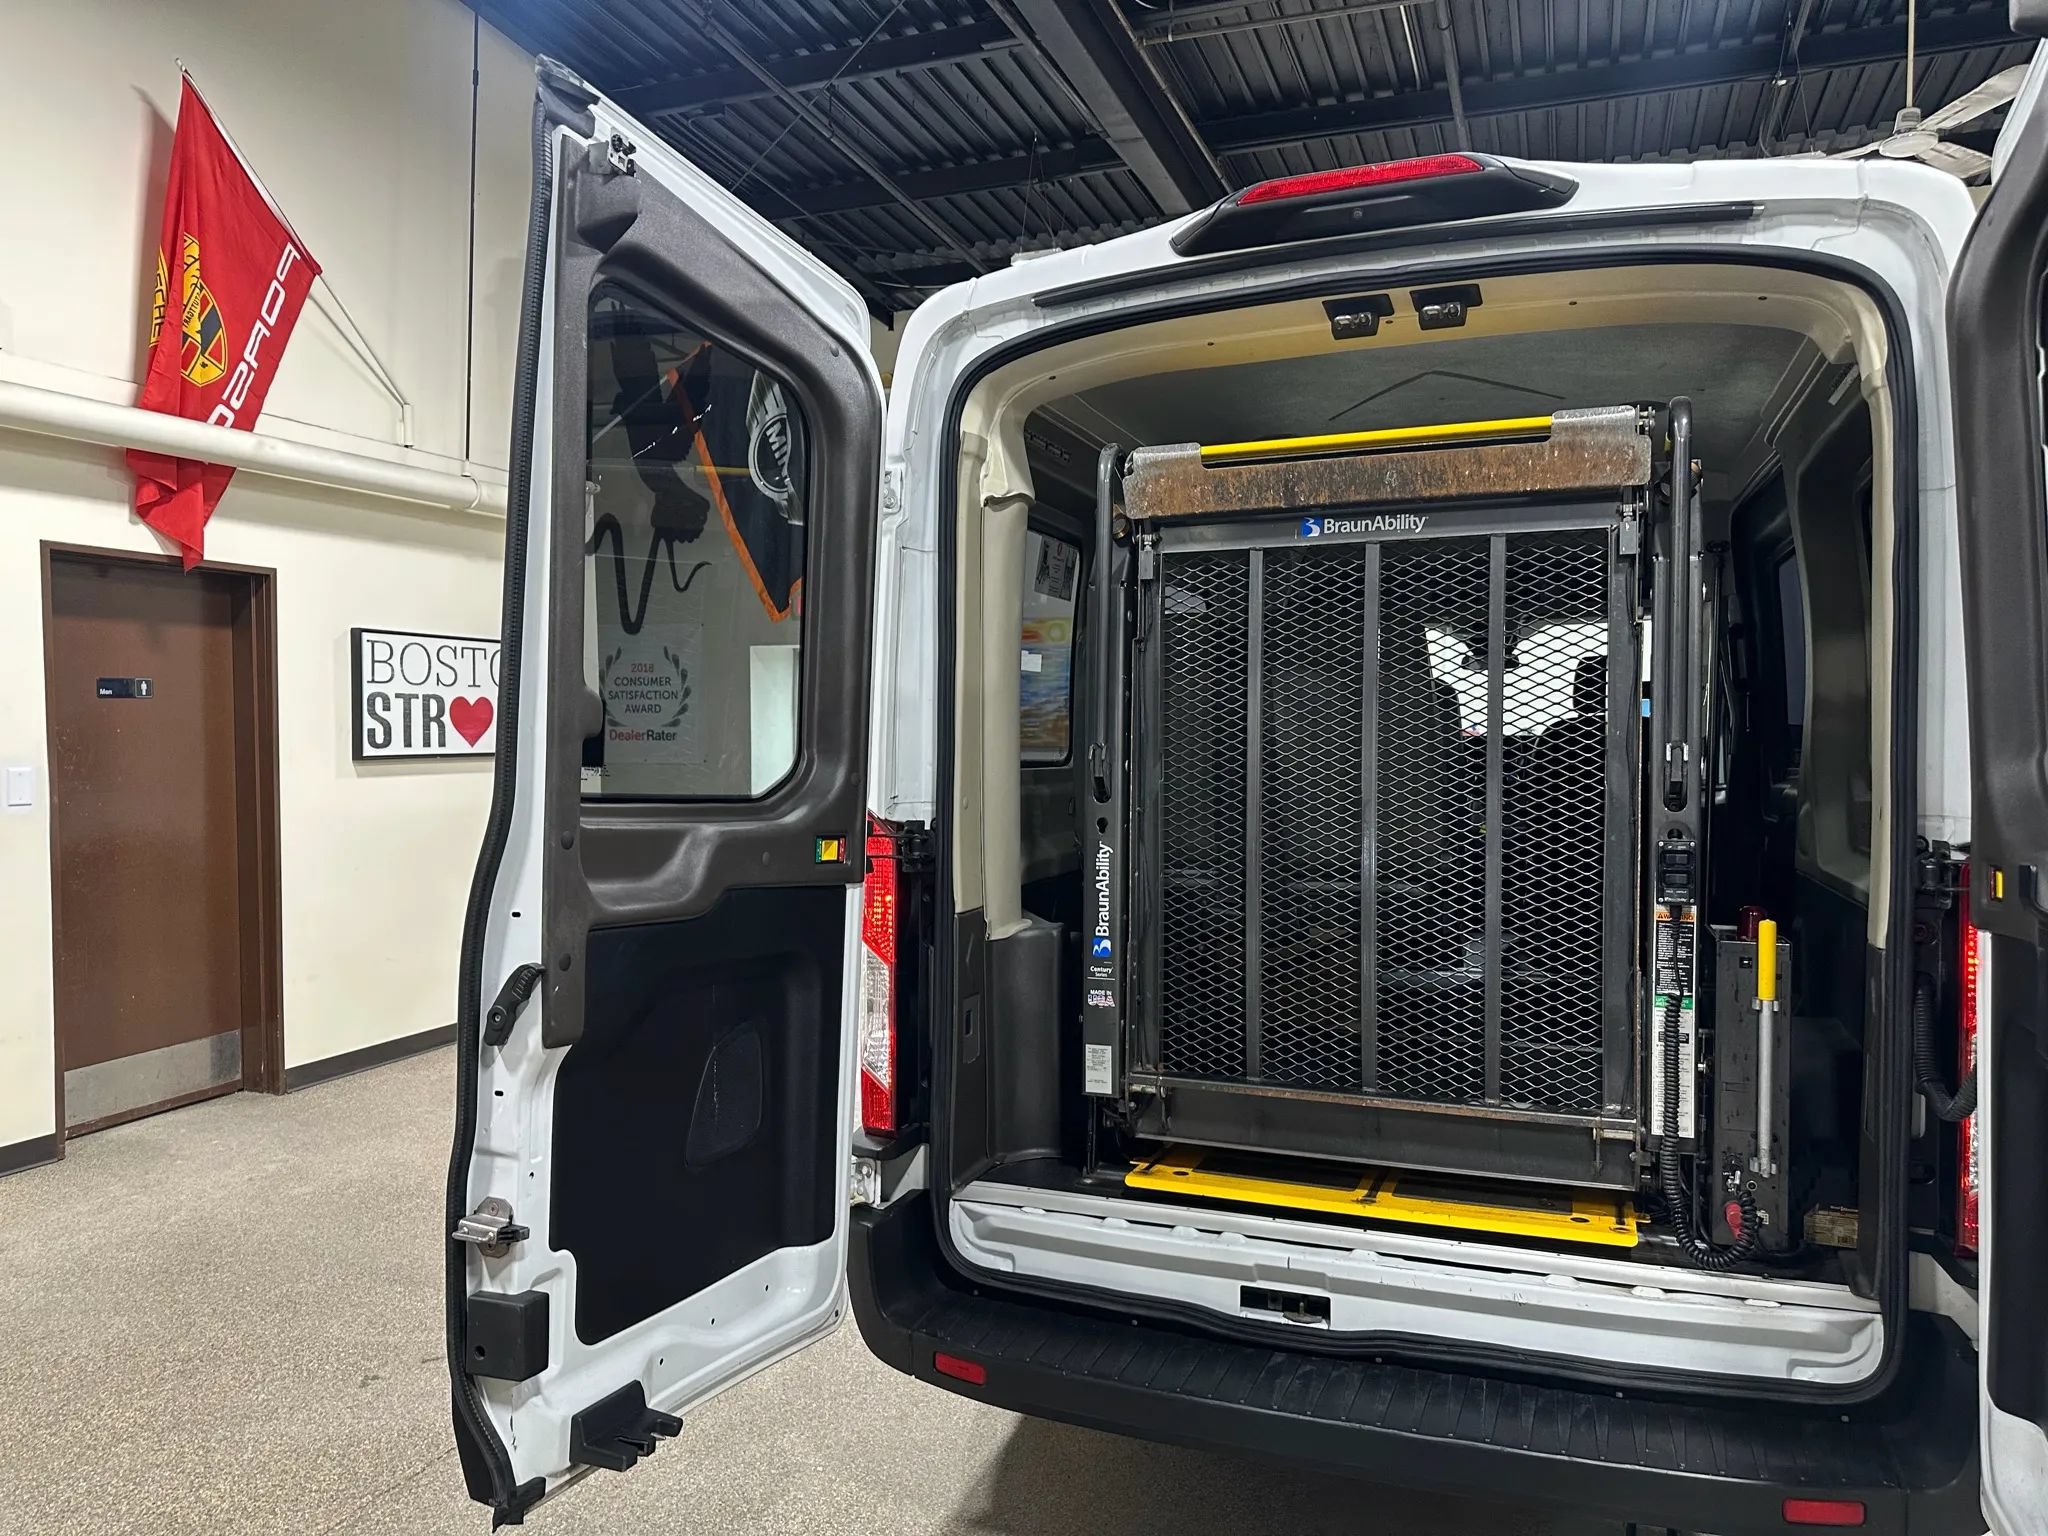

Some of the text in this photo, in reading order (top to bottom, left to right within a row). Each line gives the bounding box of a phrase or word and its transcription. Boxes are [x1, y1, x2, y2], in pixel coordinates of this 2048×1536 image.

[1323, 513, 1427, 534] BraunAbility
[367, 639, 500, 687] BOST
[631, 663, 654, 673] 2018
[614, 676, 671, 687] CONSUMER
[608, 689, 678, 700] SATISFACTION
[624, 703, 662, 714] AWARD
[367, 691, 446, 749] STR
[609, 728, 678, 741] DealerRater
[1095, 842, 1114, 937] BraunAbility
[1090, 965, 1113, 975] Century
